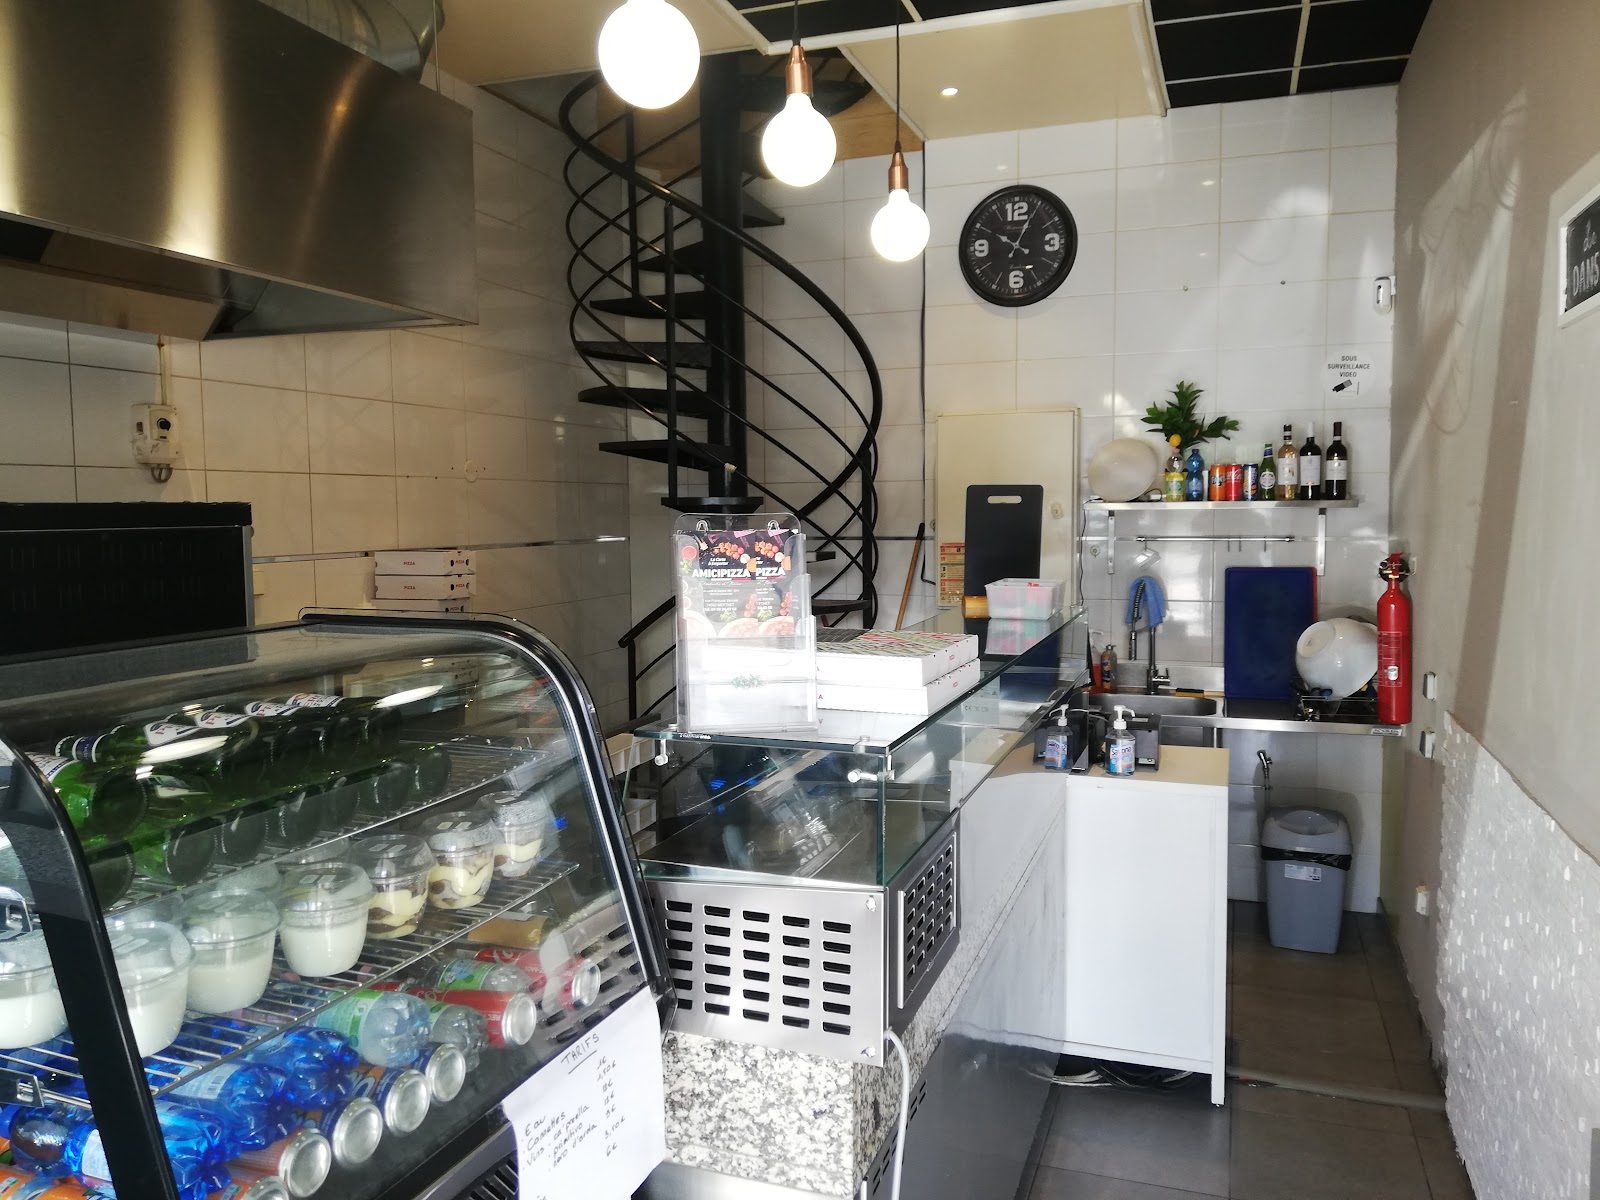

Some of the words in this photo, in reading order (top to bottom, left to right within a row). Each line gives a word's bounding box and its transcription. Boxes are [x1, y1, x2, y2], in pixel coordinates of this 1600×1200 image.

[1005, 201, 1029, 221] 12
[974, 239, 990, 258] 9
[1044, 232, 1060, 252] 3
[1008, 270, 1025, 289] 6
[692, 568, 751, 578] AMICIPIZZA
[561, 1033, 600, 1064] TARIFS
[525, 1115, 546, 1137] Eau
